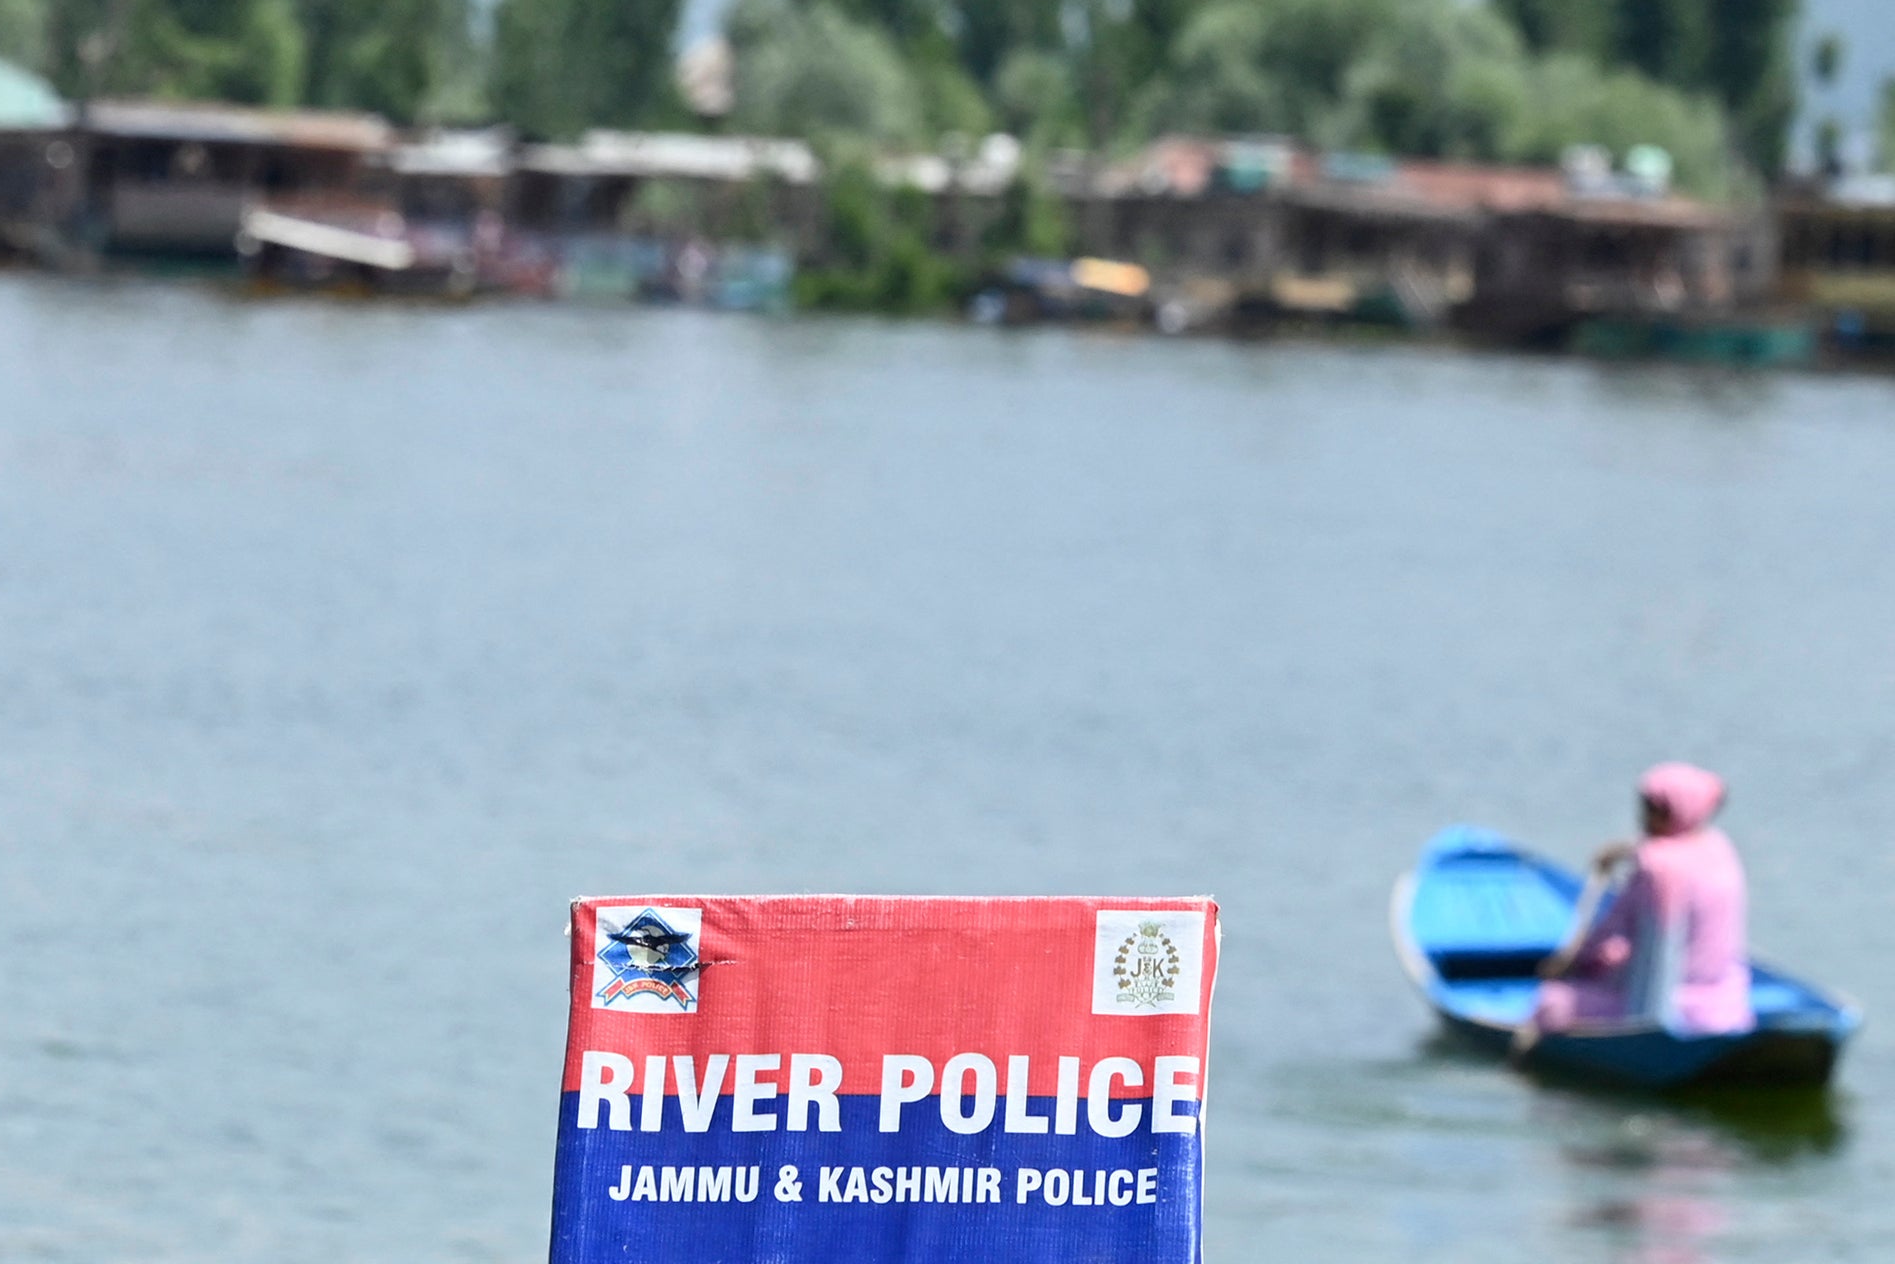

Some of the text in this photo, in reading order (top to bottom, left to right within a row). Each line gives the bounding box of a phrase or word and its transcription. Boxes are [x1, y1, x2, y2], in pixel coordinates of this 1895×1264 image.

[577, 1050, 1200, 1139] RIVER POLICE
[609, 1164, 1158, 1206] JAMMU & KASHMIR POLICE
